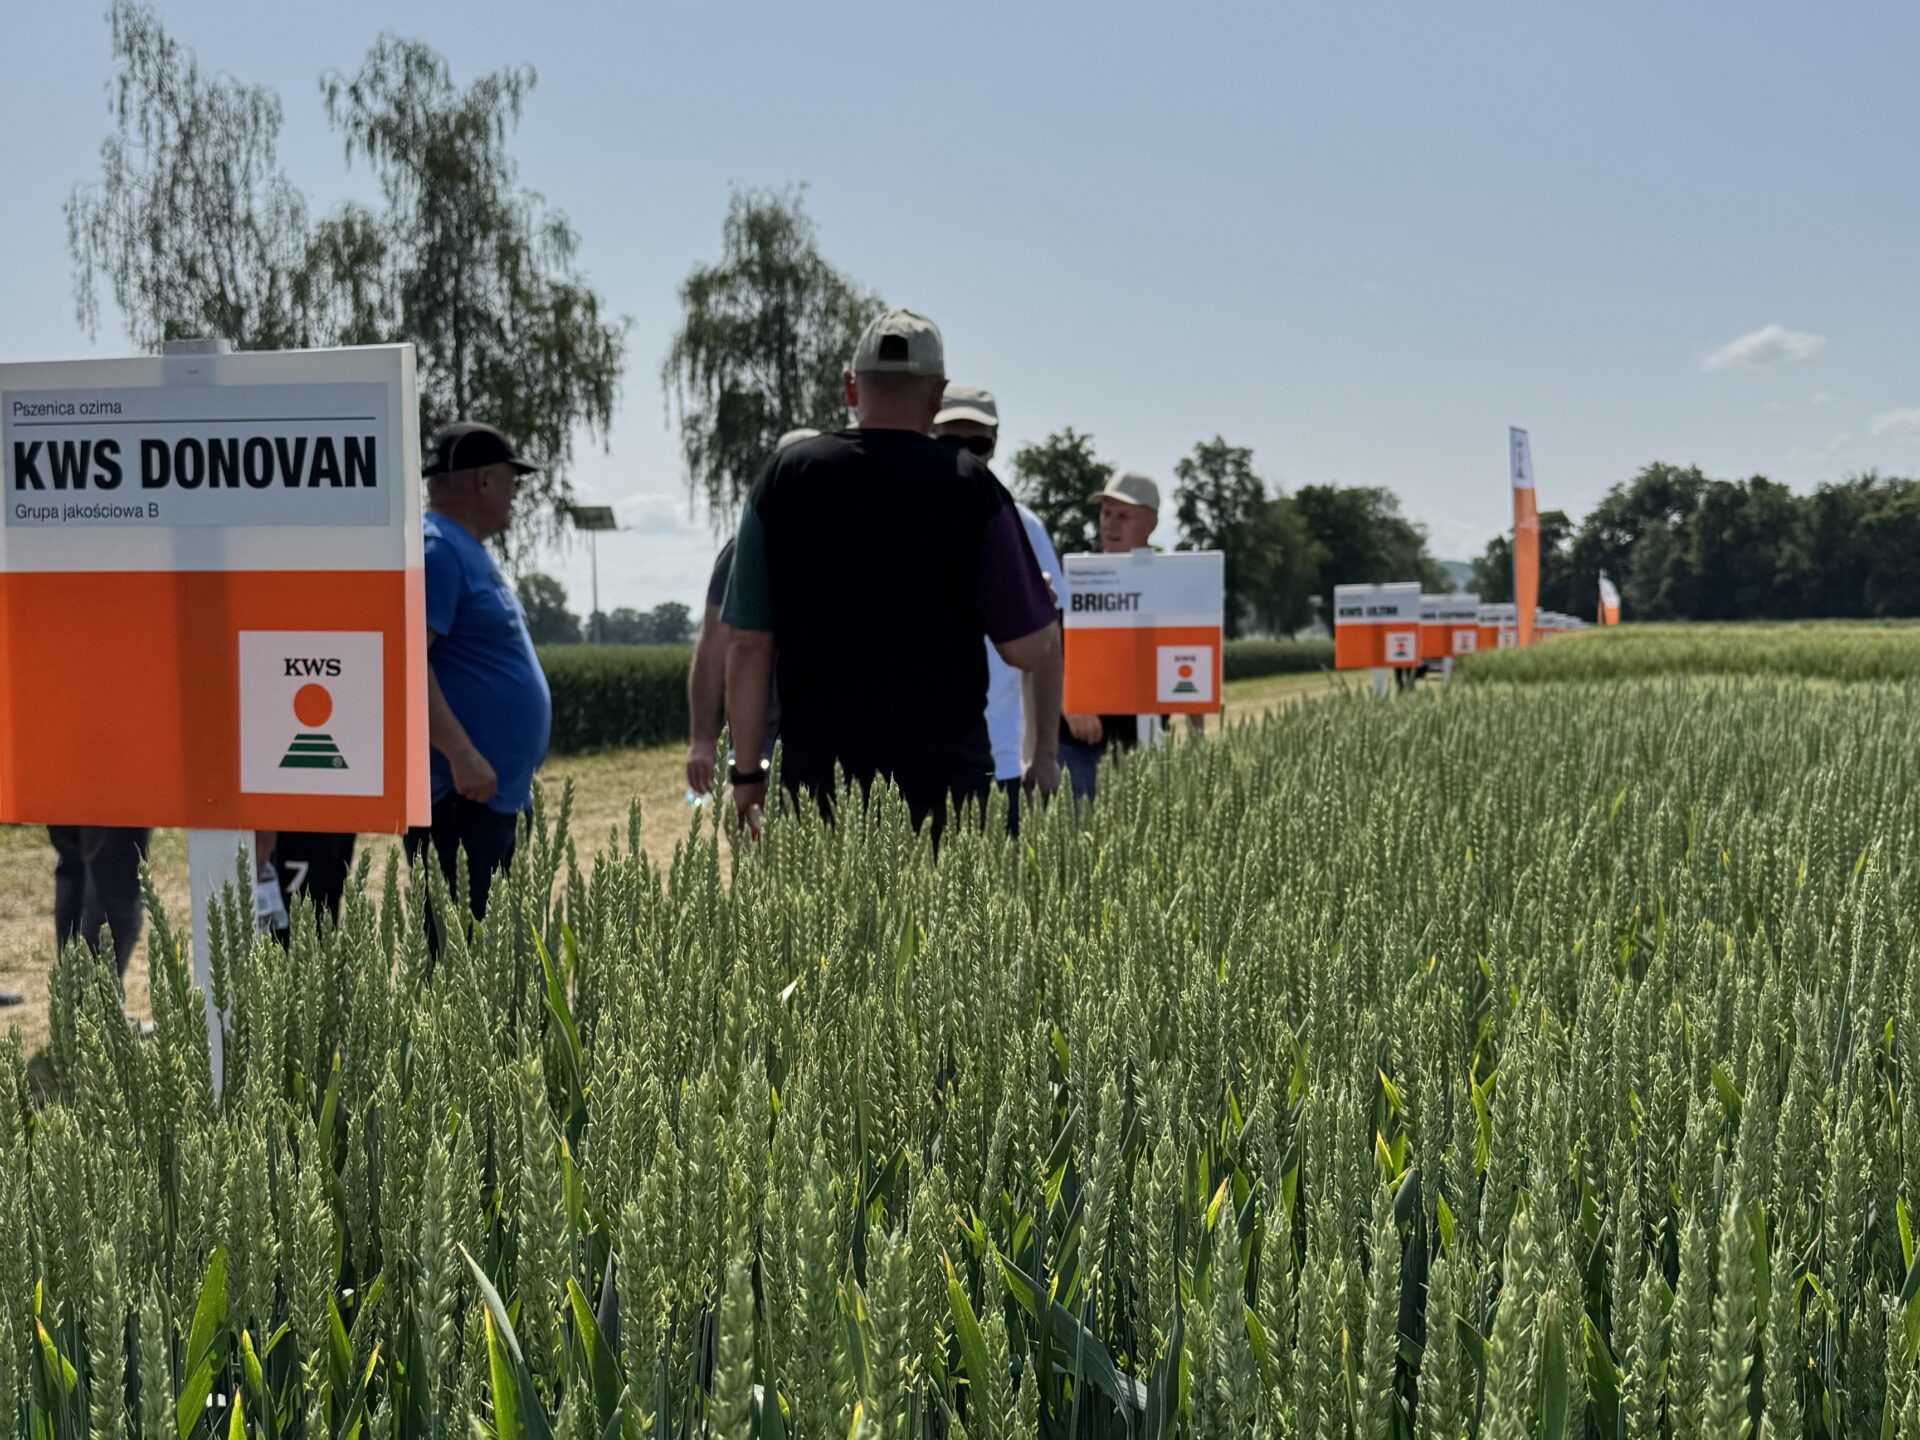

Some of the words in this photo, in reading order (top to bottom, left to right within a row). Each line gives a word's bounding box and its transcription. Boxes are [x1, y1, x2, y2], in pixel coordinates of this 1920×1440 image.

[13, 401, 75, 417] Pszenica
[79, 400, 123, 415] ozima
[13, 438, 123, 490] KWS
[140, 436, 378, 489] DONOVAN
[15, 503, 59, 522] Grupa
[62, 502, 144, 522] jakościowa
[148, 502, 160, 518] B
[1071, 592, 1142, 612] BRIGHT
[284, 658, 342, 676] KWS
[283, 860, 310, 894] 7
